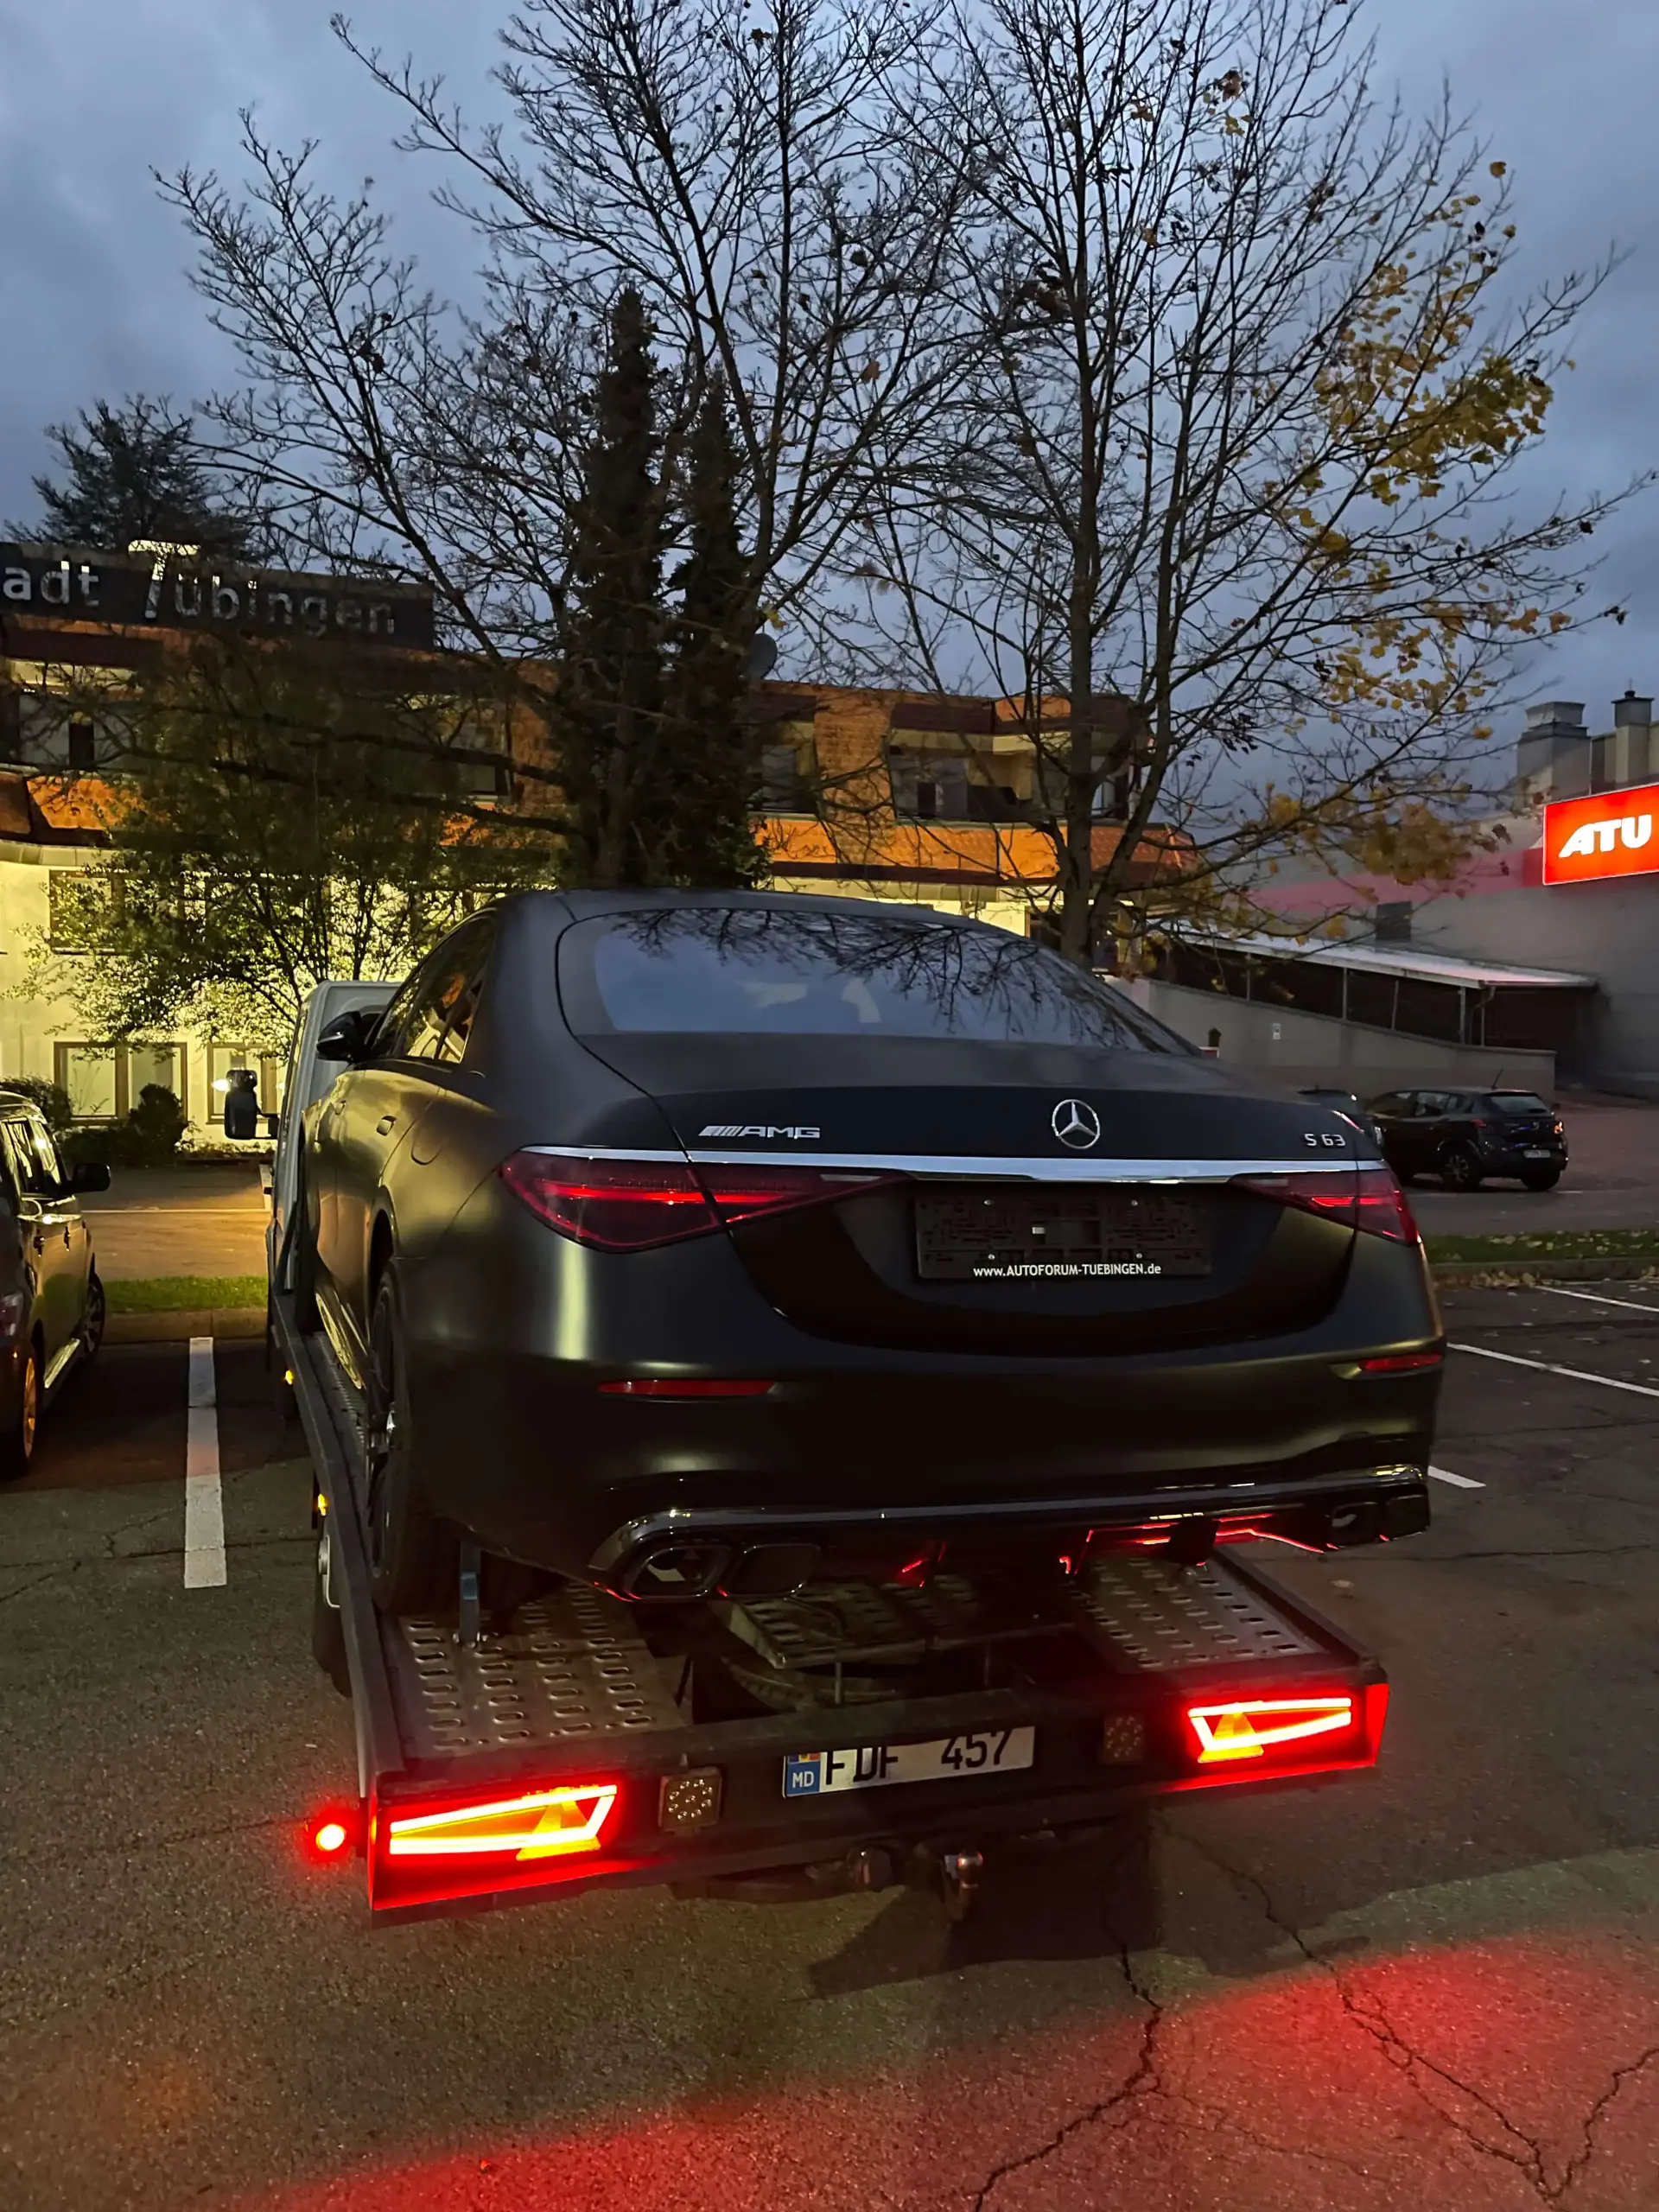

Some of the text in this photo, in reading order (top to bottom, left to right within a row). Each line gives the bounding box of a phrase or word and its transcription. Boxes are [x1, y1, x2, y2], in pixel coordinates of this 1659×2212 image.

[127, 538, 396, 636] Tübingen
[1558, 814, 1652, 858] ATU
[737, 1126, 821, 1139] AMG
[1304, 1133, 1346, 1147] S 63
[973, 1263, 1162, 1277] www.AUTOFORUM-TUEBINGEN.de
[791, 1770, 815, 1789] MD
[940, 1729, 1013, 1770] 457
